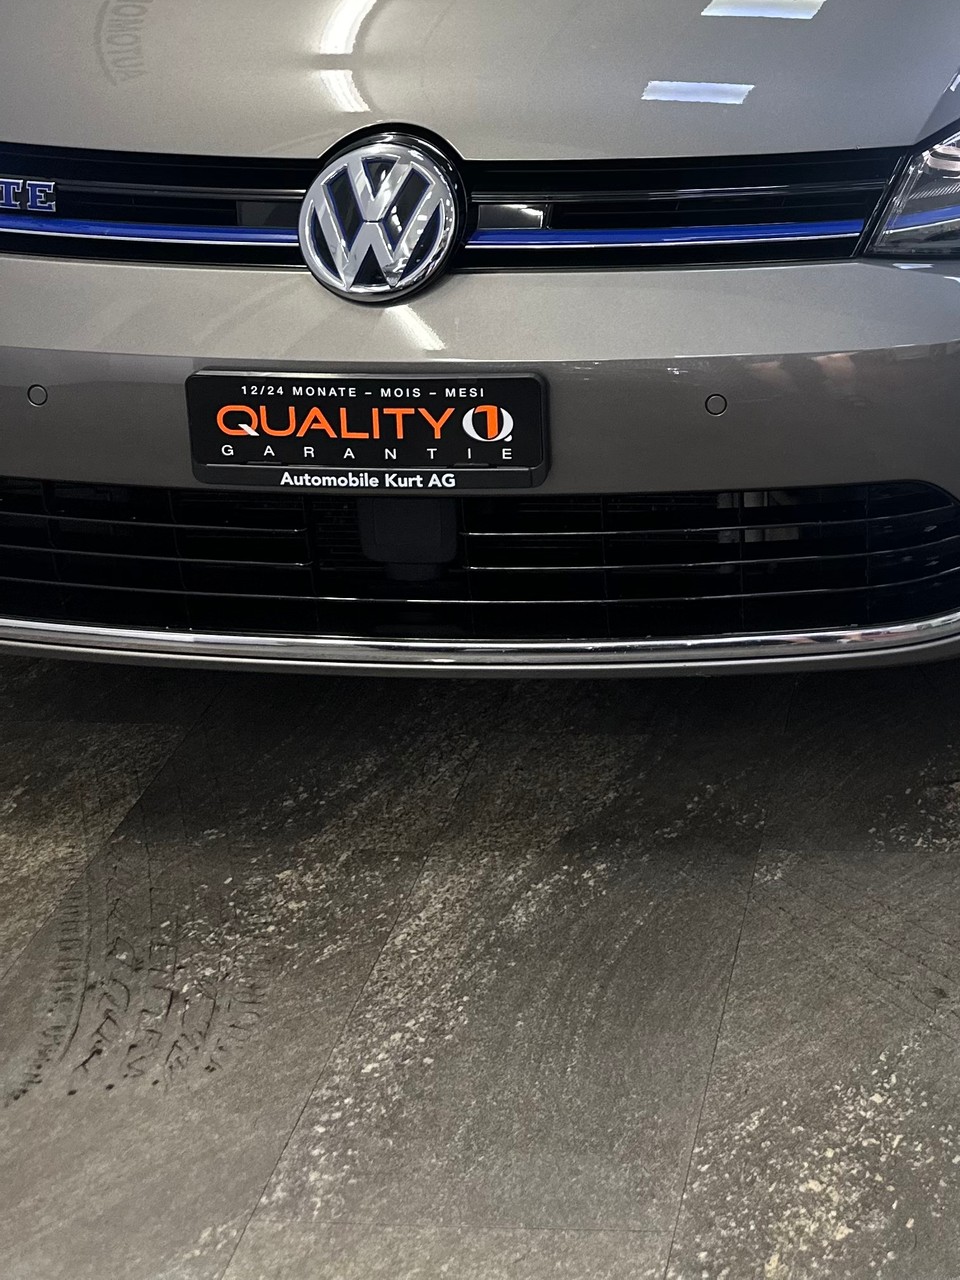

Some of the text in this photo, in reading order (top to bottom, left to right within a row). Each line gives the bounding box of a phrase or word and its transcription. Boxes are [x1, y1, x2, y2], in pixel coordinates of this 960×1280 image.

[241, 385, 284, 396] 12/24
[292, 386, 357, 398] MONATE
[380, 387, 421, 398] MOIS
[445, 387, 484, 398] MESI
[216, 404, 456, 440] QUALITY
[221, 444, 513, 461] GARANTIE
[280, 471, 456, 488] Automobile Kurt AG
